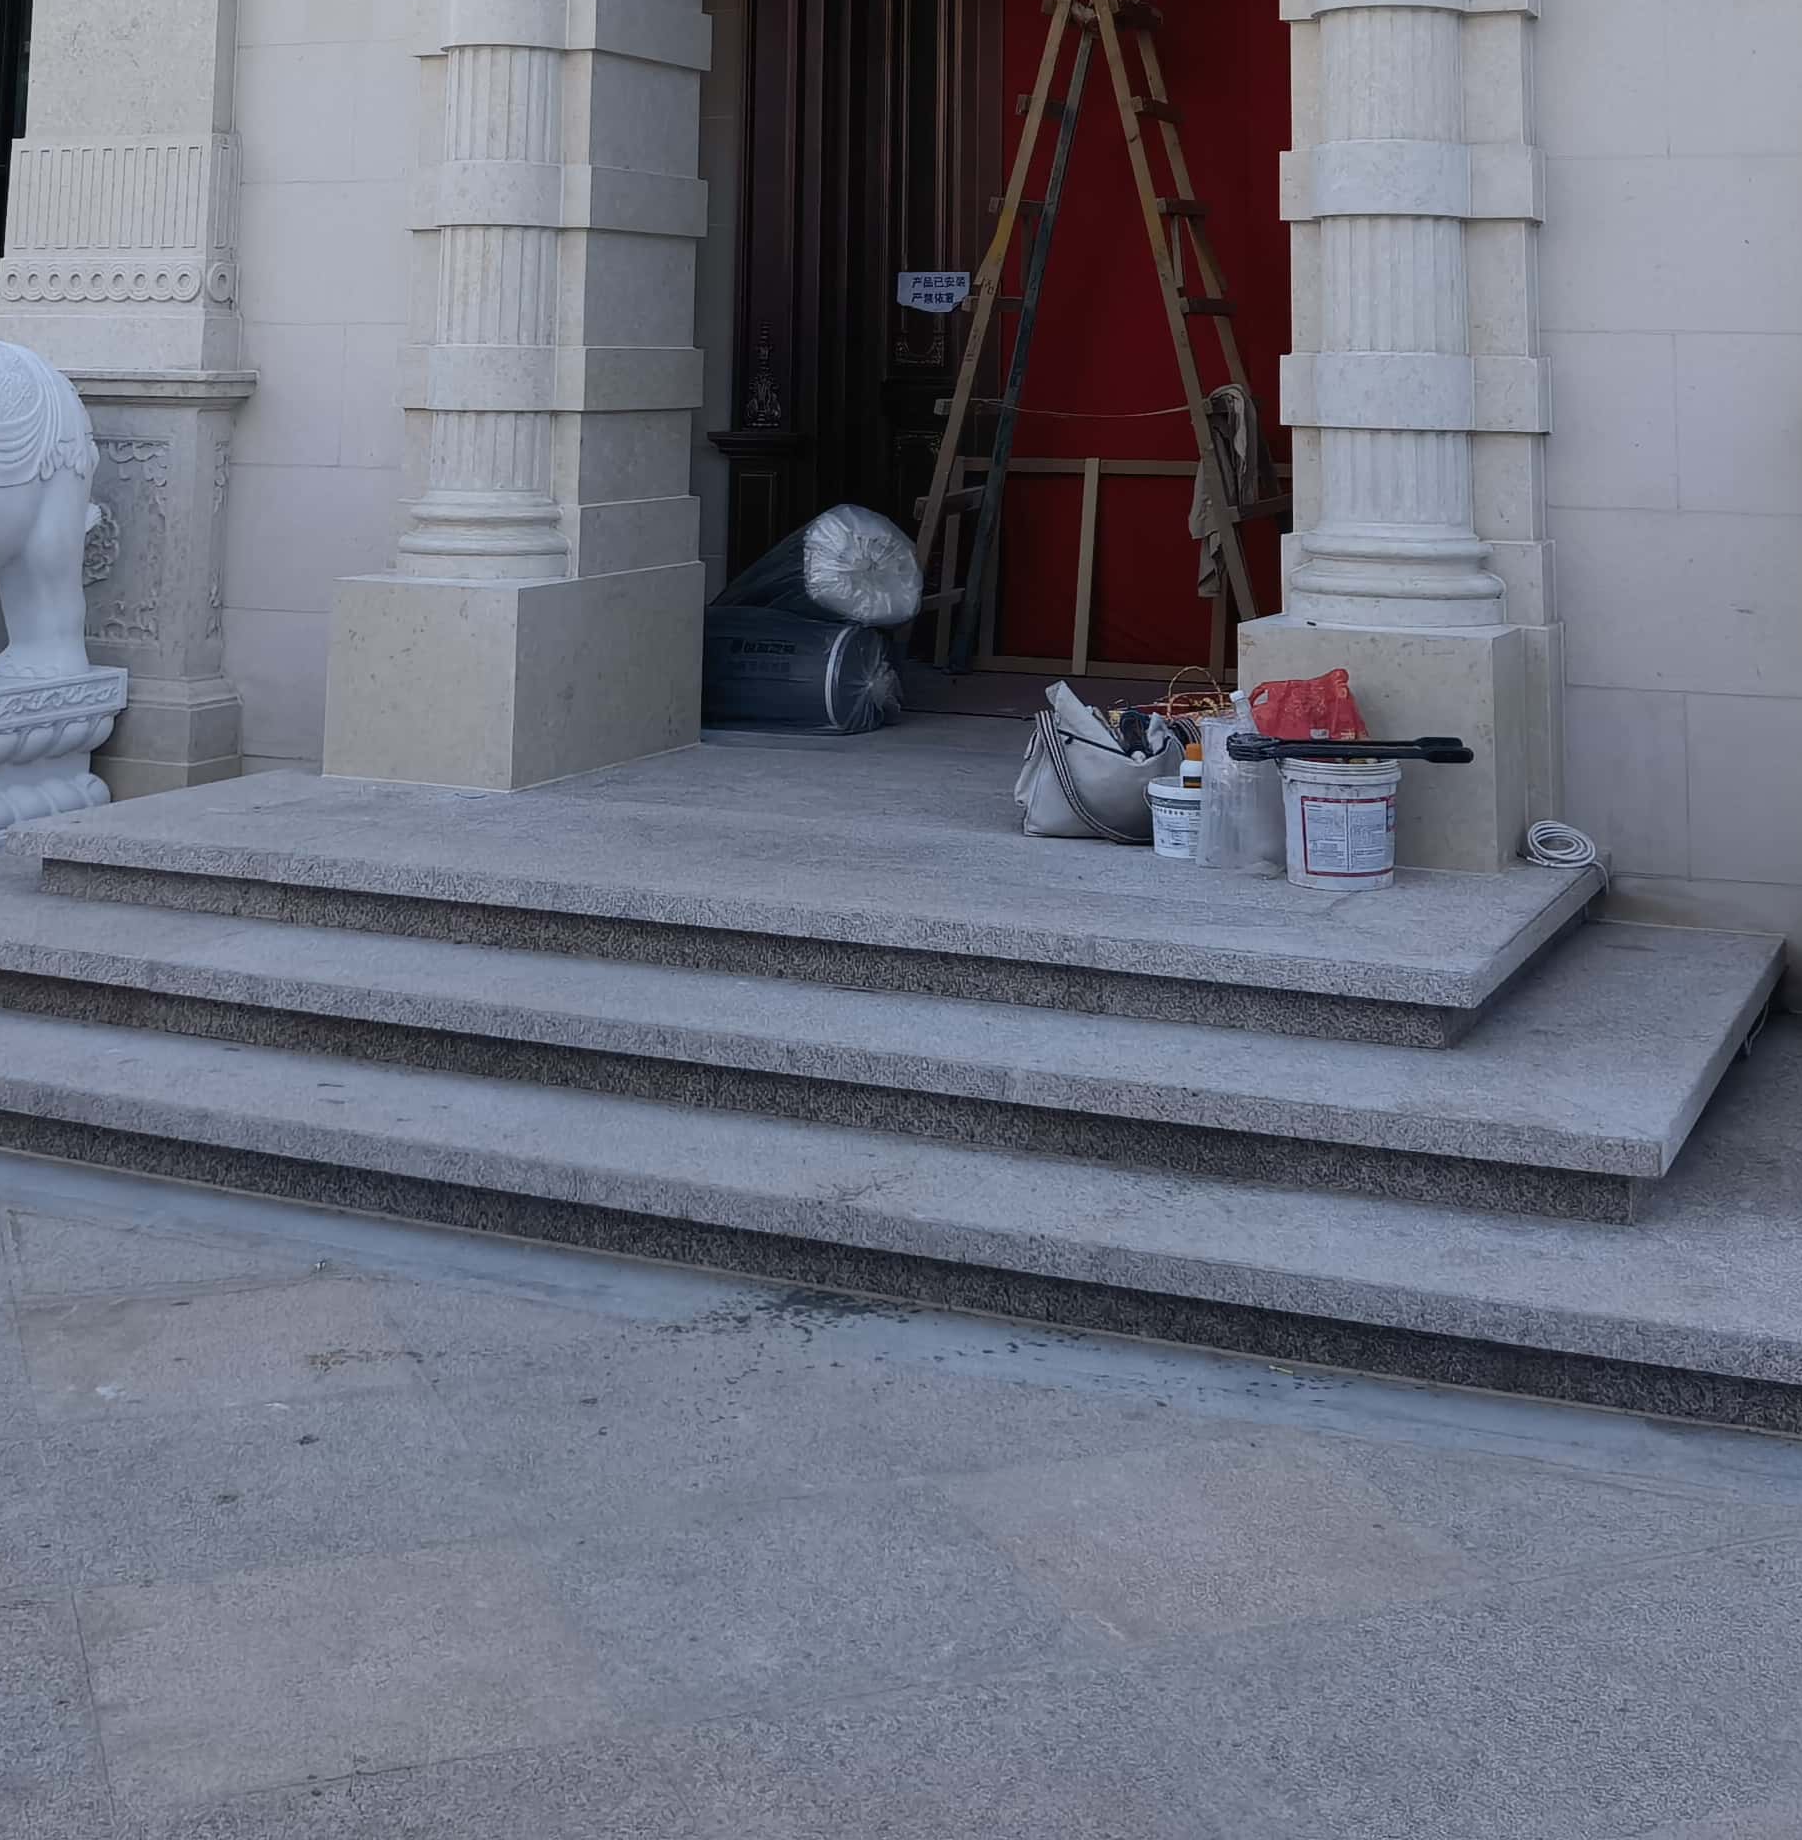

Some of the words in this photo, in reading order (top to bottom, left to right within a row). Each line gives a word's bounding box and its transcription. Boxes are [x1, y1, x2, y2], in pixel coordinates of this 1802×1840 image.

[911, 276, 966, 288] 产品已安装
